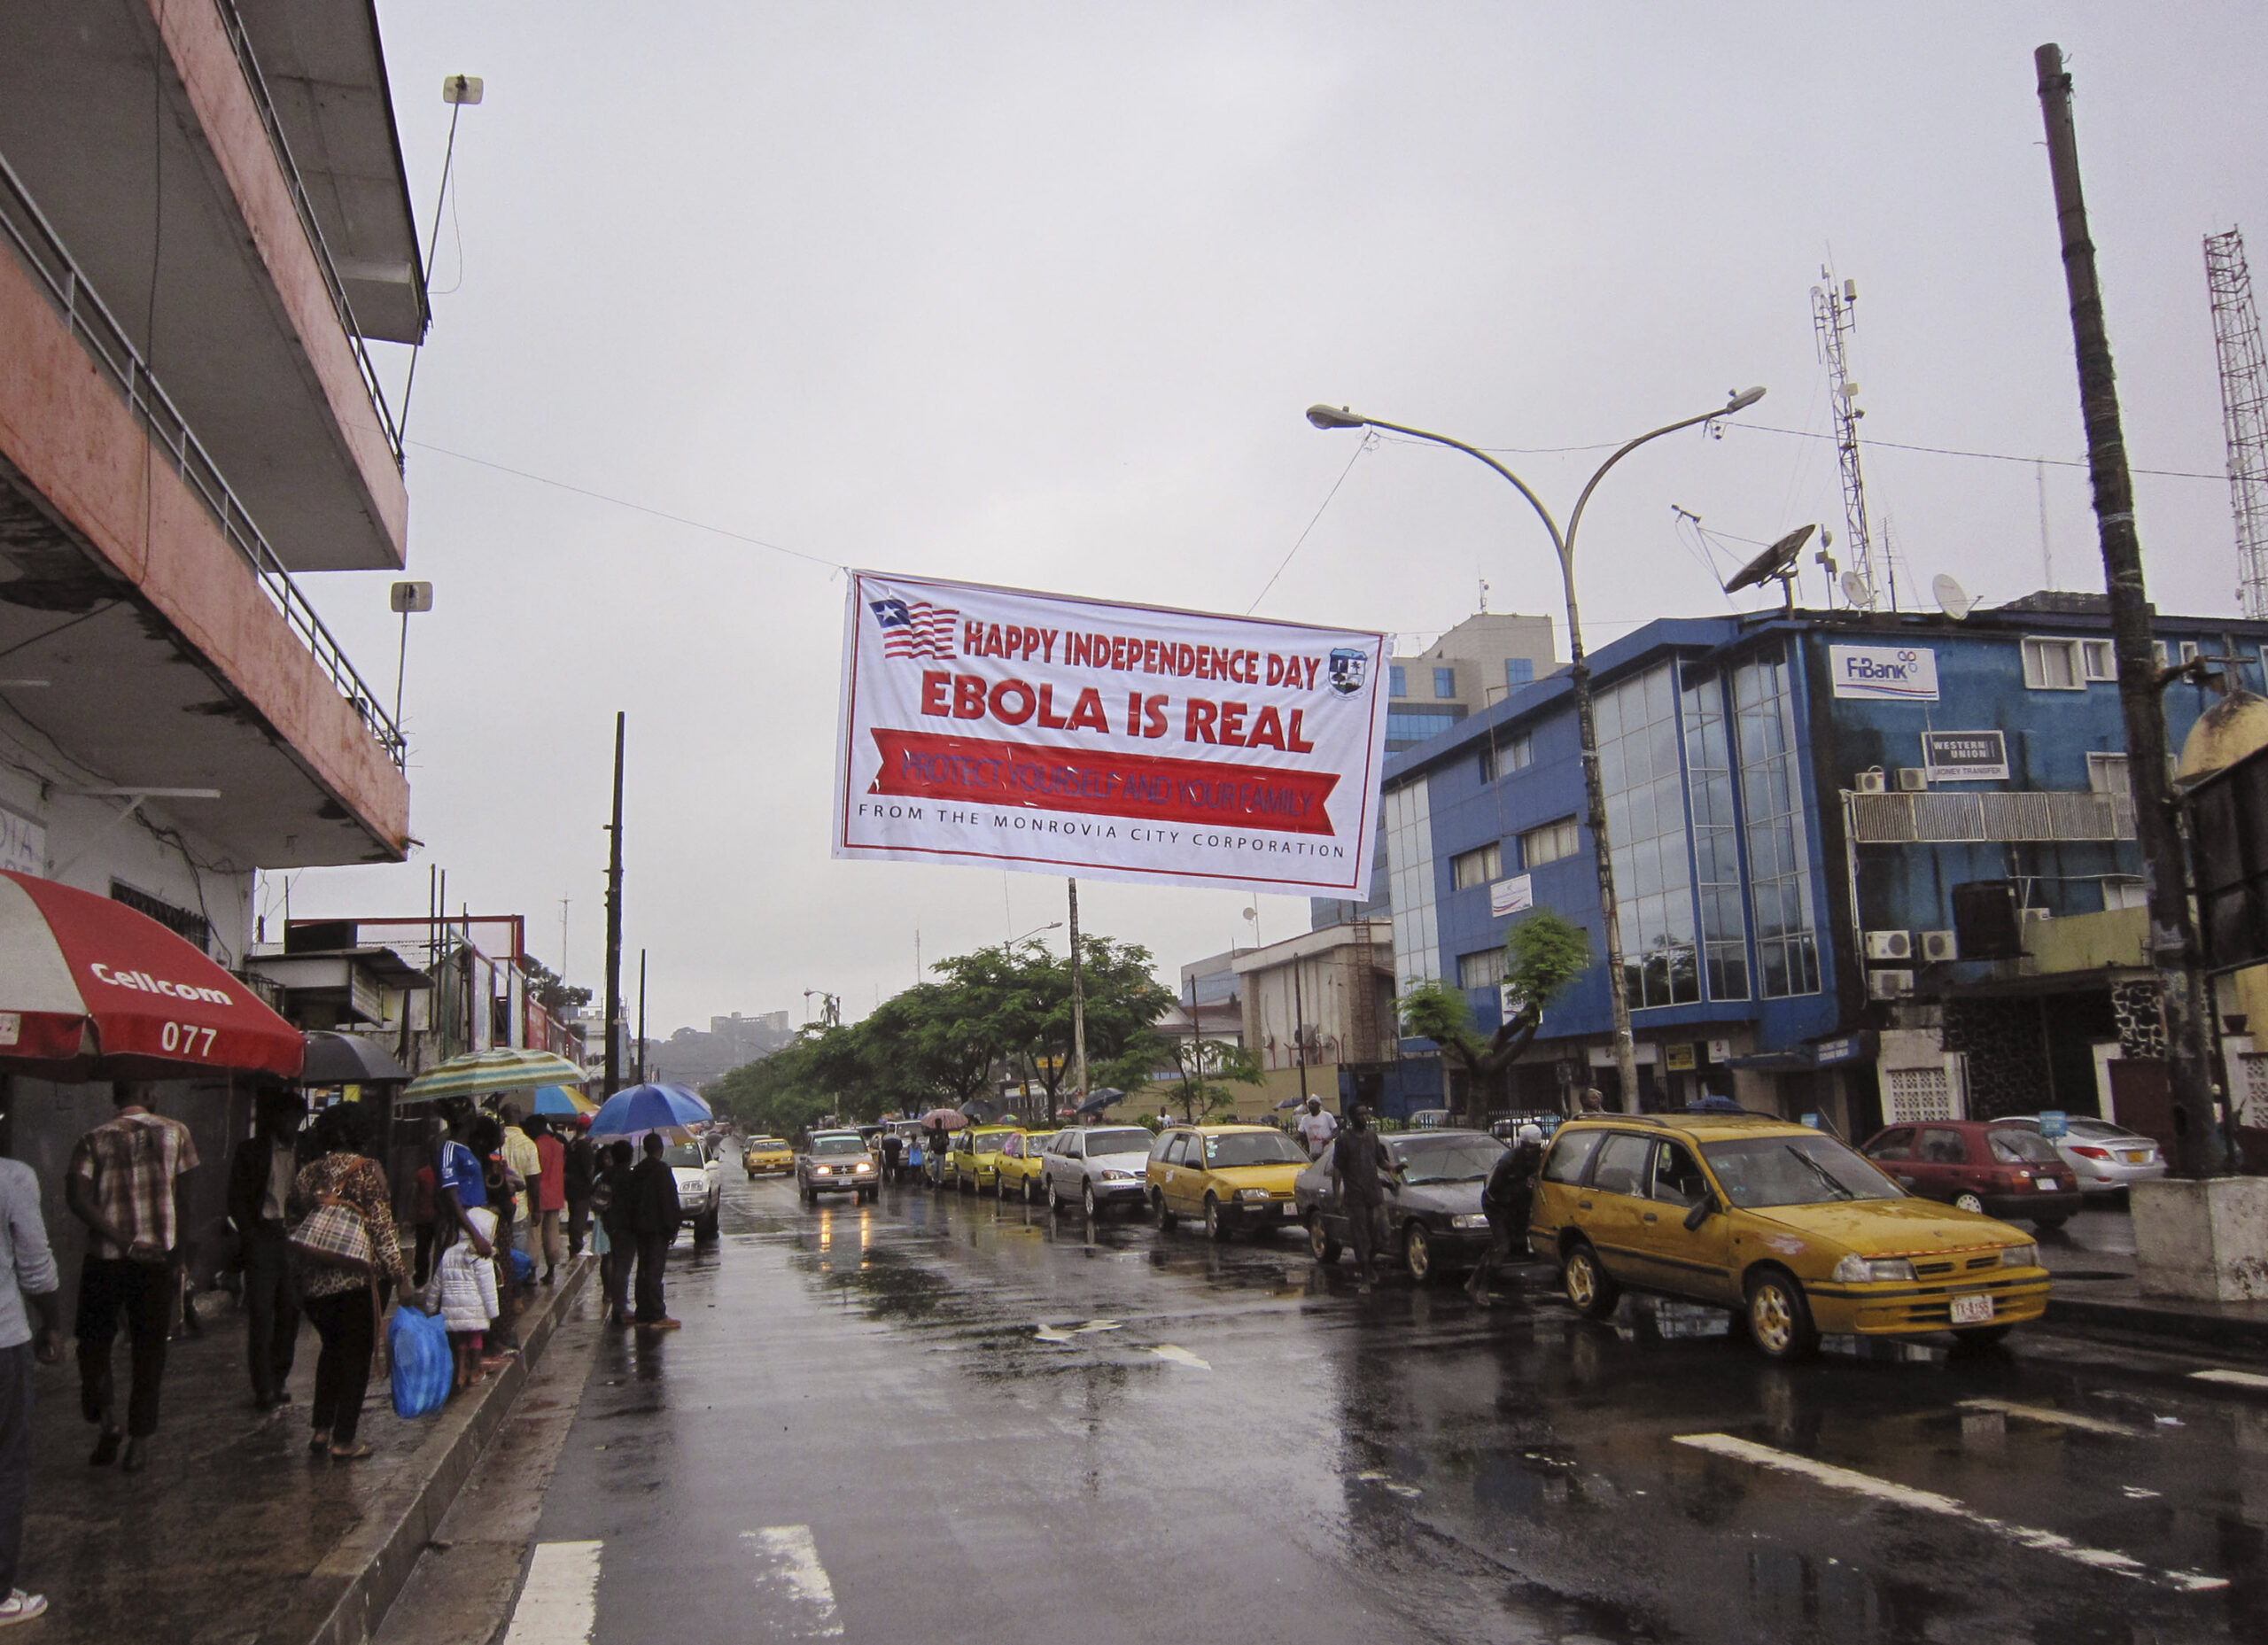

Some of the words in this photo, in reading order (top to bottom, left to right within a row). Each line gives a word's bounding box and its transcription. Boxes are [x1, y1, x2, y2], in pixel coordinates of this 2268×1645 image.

[963, 620, 1059, 663] HAPPY
[1064, 631, 1259, 685] INDEPENDENCE
[1266, 652, 1321, 691] DAY
[921, 670, 1110, 733] EBOLA
[1127, 691, 1169, 739] IS
[1184, 697, 1315, 754] REAL
[1932, 741, 1986, 751] WESTERN
[1951, 749, 1986, 759] UNION
[902, 751, 1003, 788] PROTECT
[1005, 761, 1122, 798] YOURSELF
[1122, 773, 1172, 804] AND
[1177, 778, 1237, 810] YOUR
[1240, 783, 1315, 817] FAMILY
[858, 803, 923, 819] FROM
[937, 809, 980, 825] THE
[993, 814, 1117, 839] MONROVIA
[1130, 827, 1180, 843] CITY
[1192, 834, 1345, 858] CORPORATION
[90, 962, 234, 1005] Cellcom
[161, 1020, 218, 1057] 077
